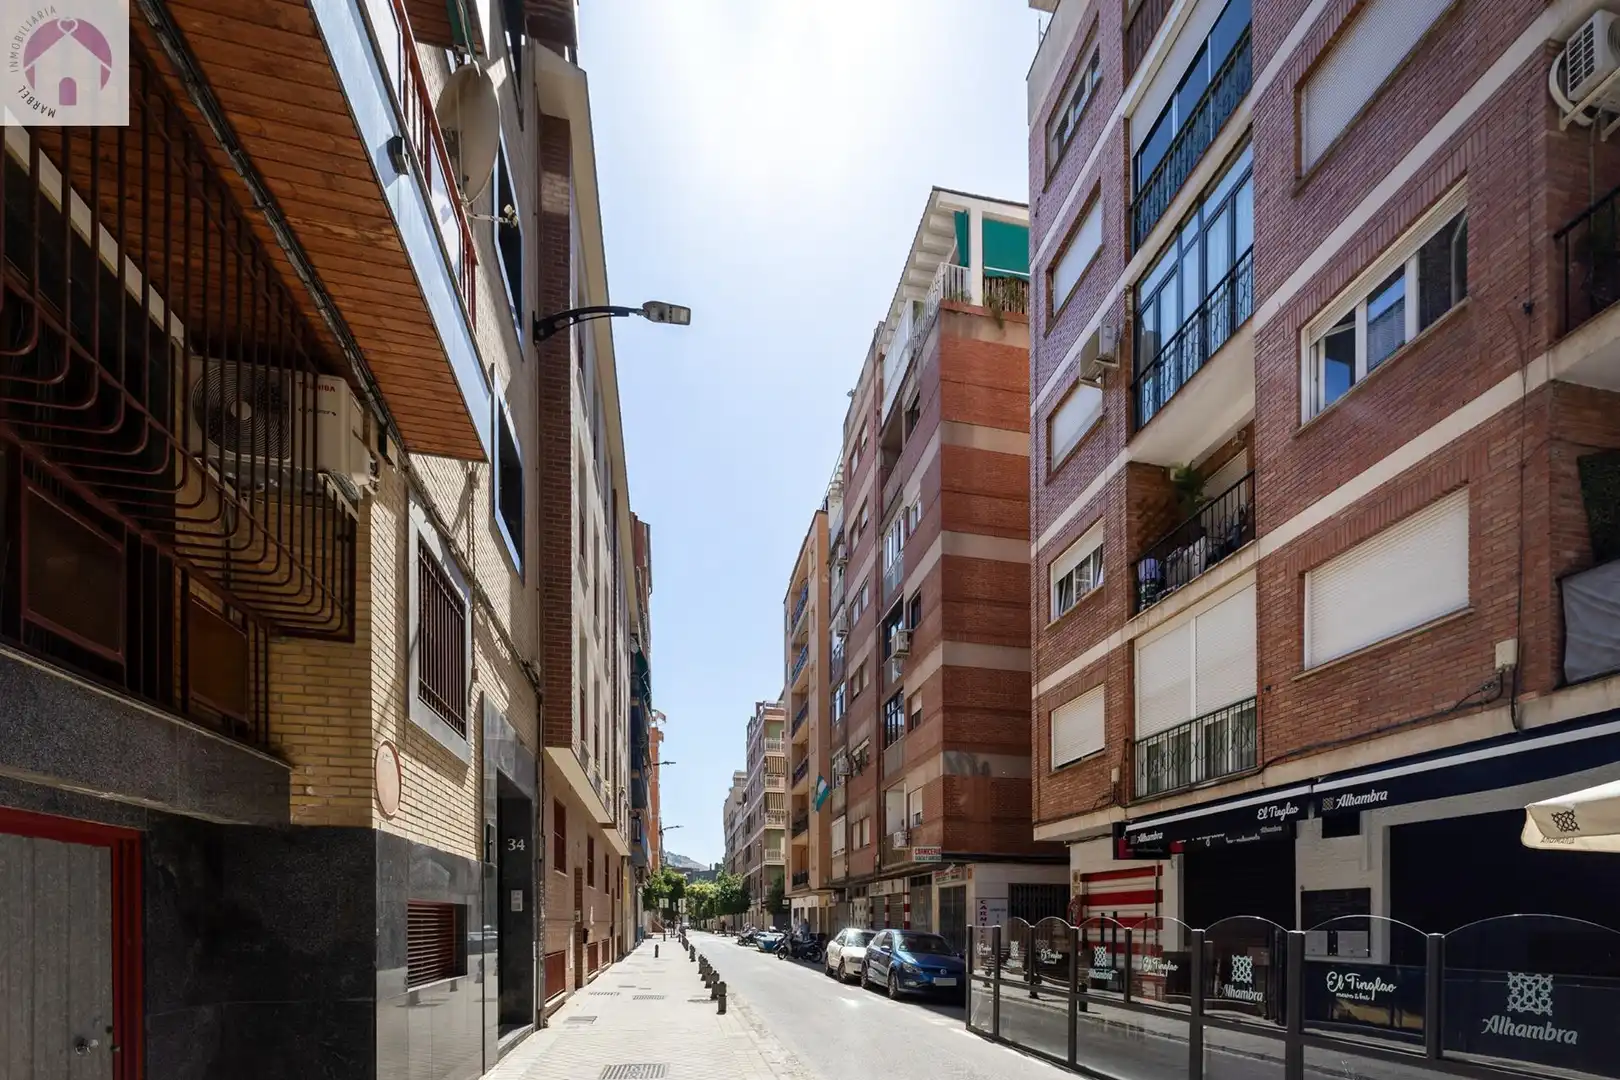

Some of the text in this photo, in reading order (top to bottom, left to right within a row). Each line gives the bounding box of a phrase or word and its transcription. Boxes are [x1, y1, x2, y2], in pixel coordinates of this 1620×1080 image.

[1335, 789, 1388, 810] Alhambra
[1257, 801, 1299, 821] El Tinglao
[507, 838, 526, 851] 34
[1220, 983, 1265, 1002] Alhambra
[1326, 971, 1397, 1001] El Tinglao
[1481, 1014, 1578, 1045] Alhambra
